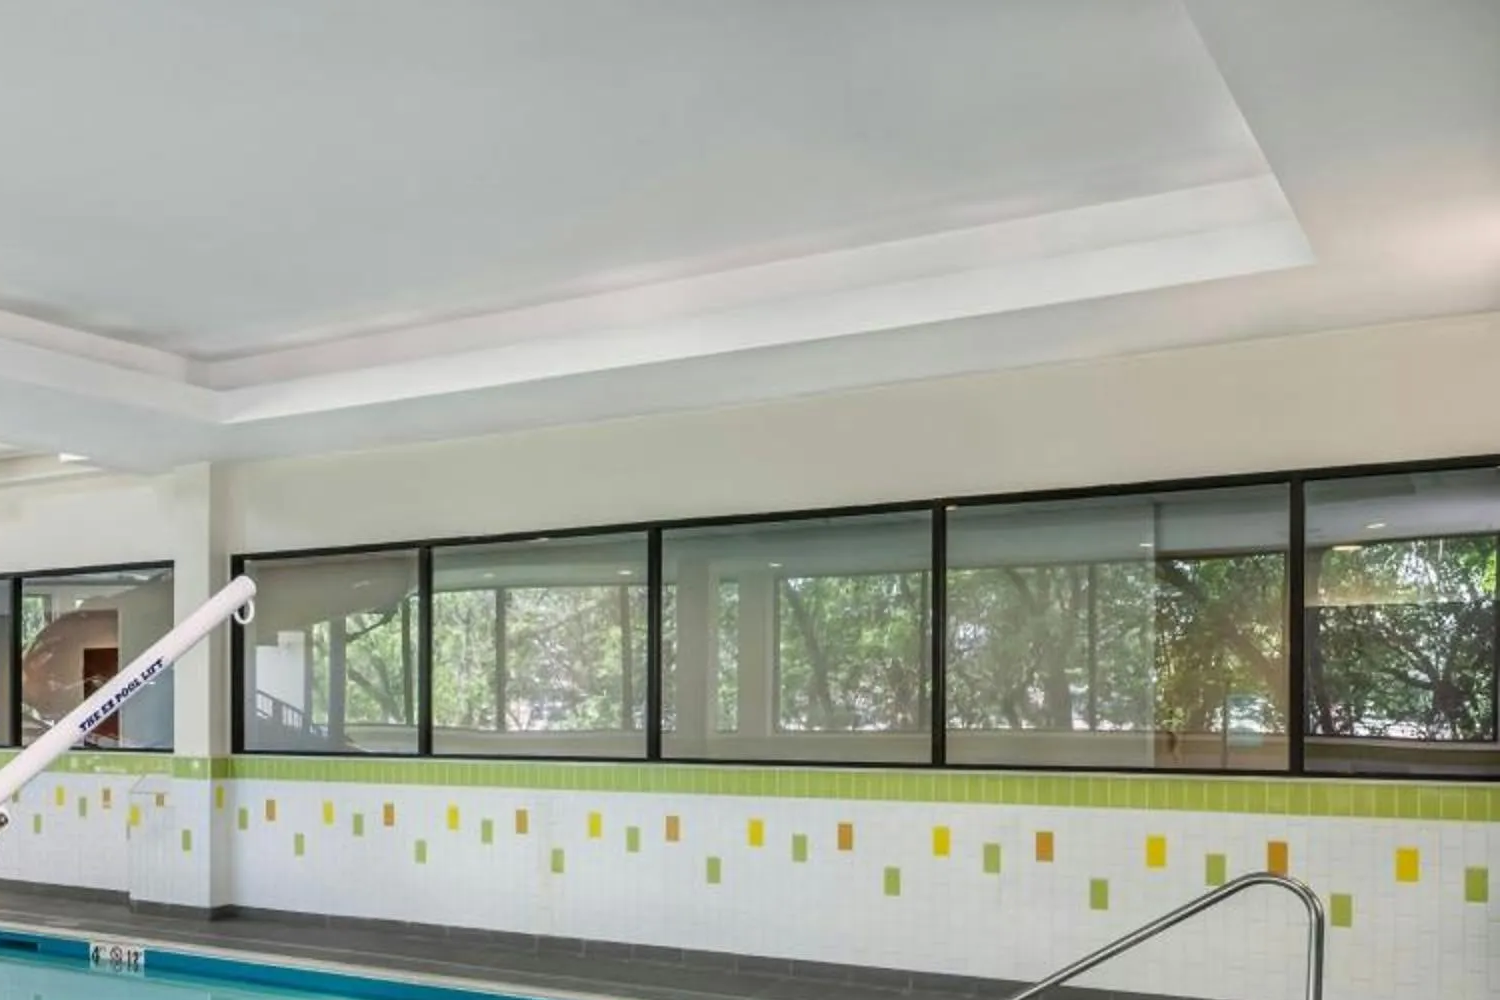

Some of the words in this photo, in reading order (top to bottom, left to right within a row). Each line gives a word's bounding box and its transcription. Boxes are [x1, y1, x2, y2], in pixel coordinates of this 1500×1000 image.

[79, 708, 102, 733] THE
[115, 677, 142, 704] POOL
[140, 657, 164, 681] LIFT
